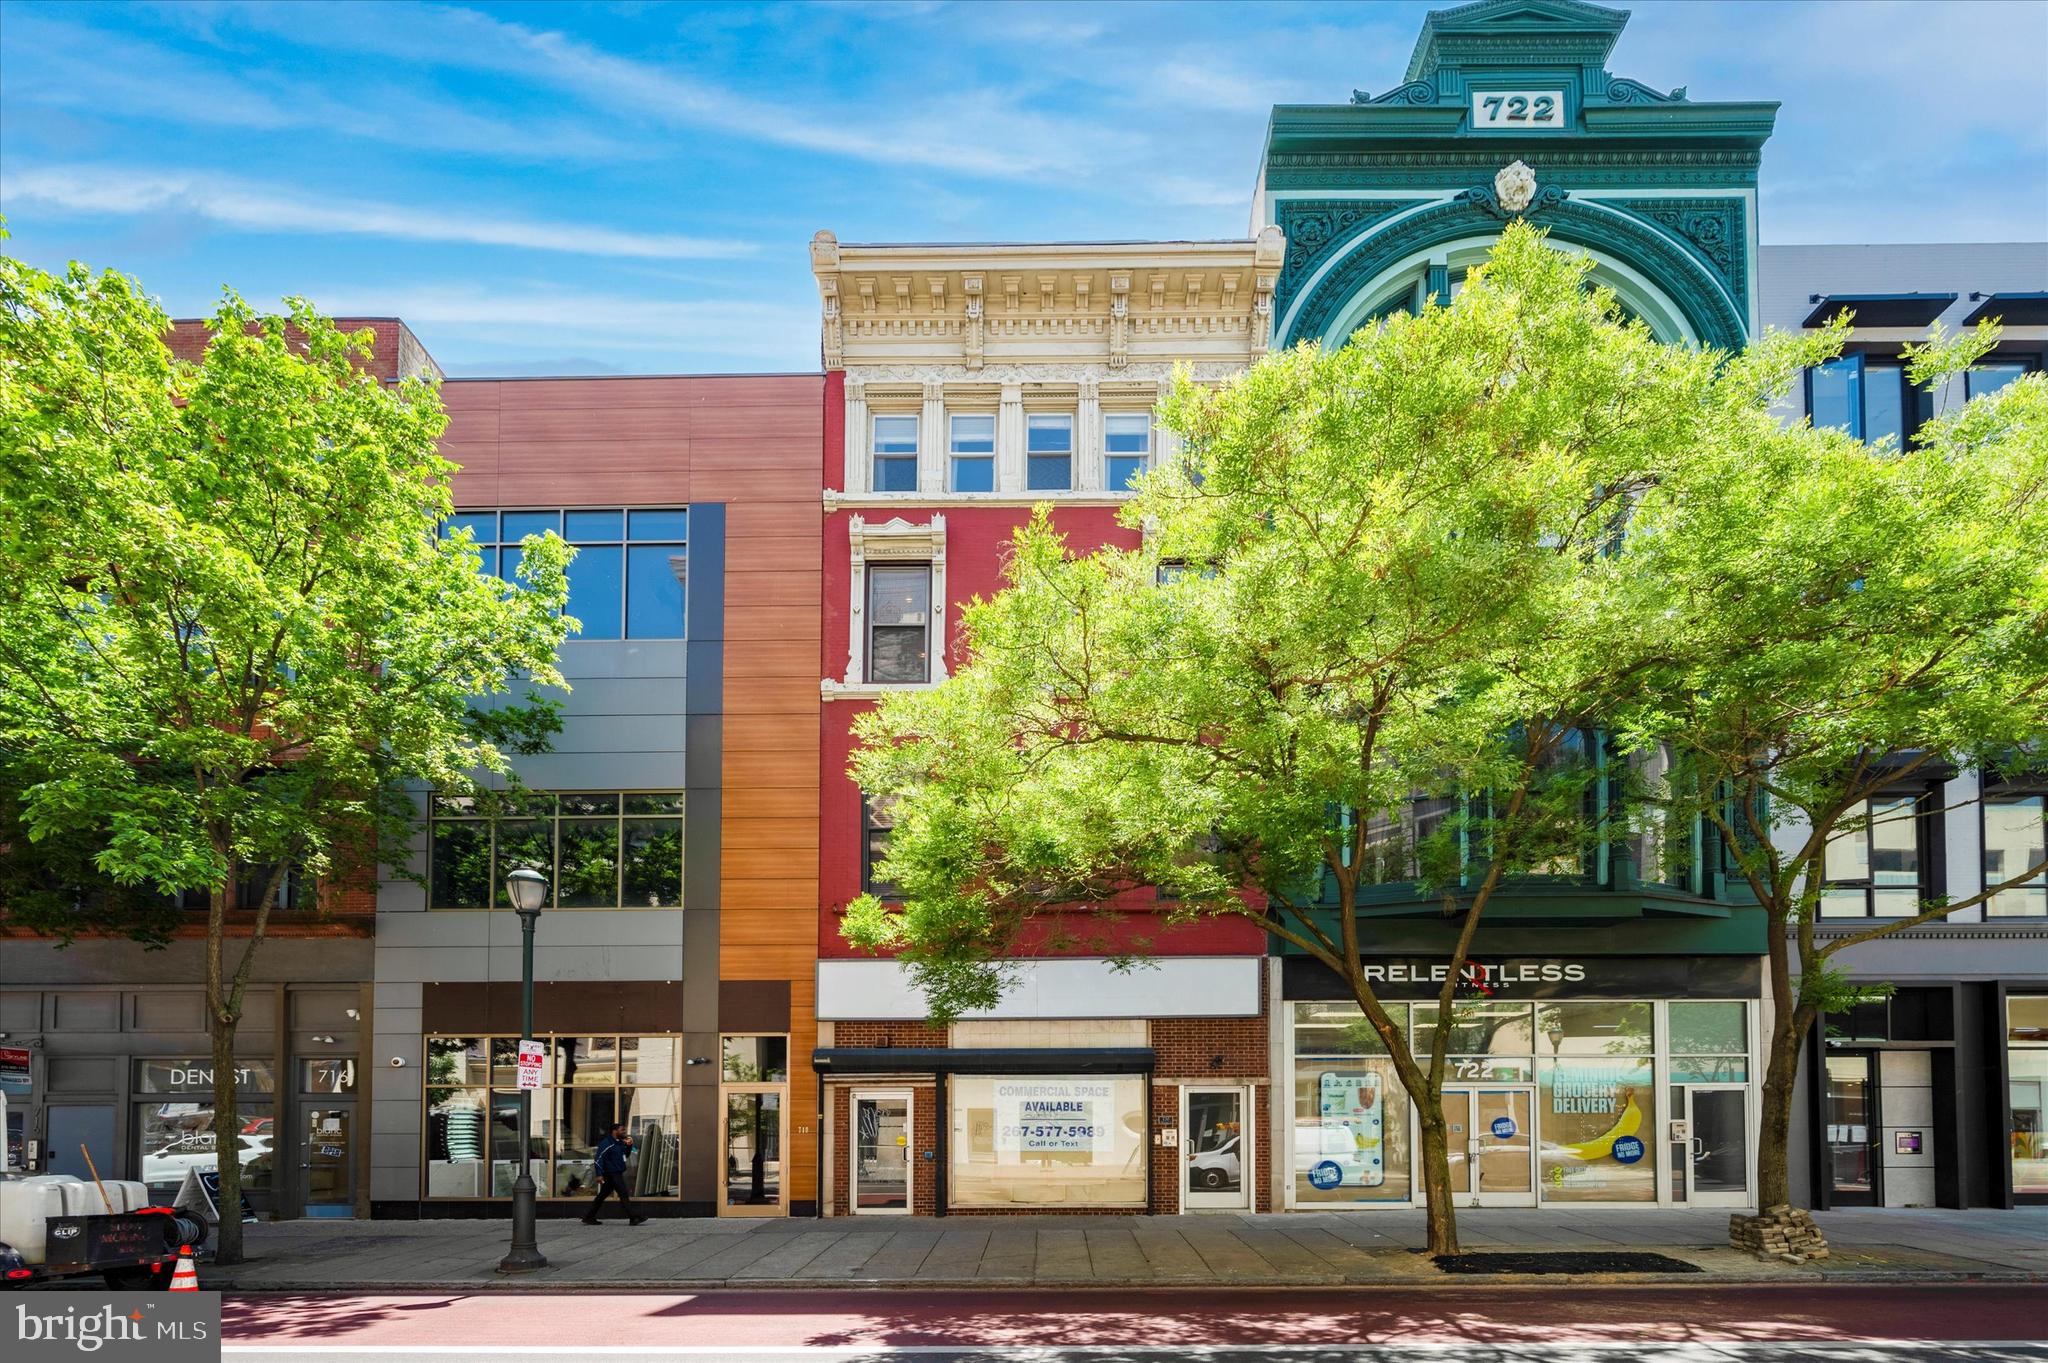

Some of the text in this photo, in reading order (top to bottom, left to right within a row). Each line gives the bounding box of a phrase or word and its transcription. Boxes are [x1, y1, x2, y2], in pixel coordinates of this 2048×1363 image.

[1482, 96, 1555, 121] 722
[1364, 964, 1586, 982] RELENTLESS
[526, 1054, 536, 1062] NO
[318, 1070, 348, 1083] 716
[1455, 1062, 1494, 1078] 722
[999, 1086, 1109, 1096] COMMERCIAL SPACE
[1553, 1082, 1616, 1097] GROCERY
[1025, 1101, 1083, 1112] AVAILABLE
[1553, 1098, 1616, 1113] DELIVERY
[1615, 1141, 1640, 1152] FRIDGE
[1617, 1148, 1641, 1159] NO MORE
